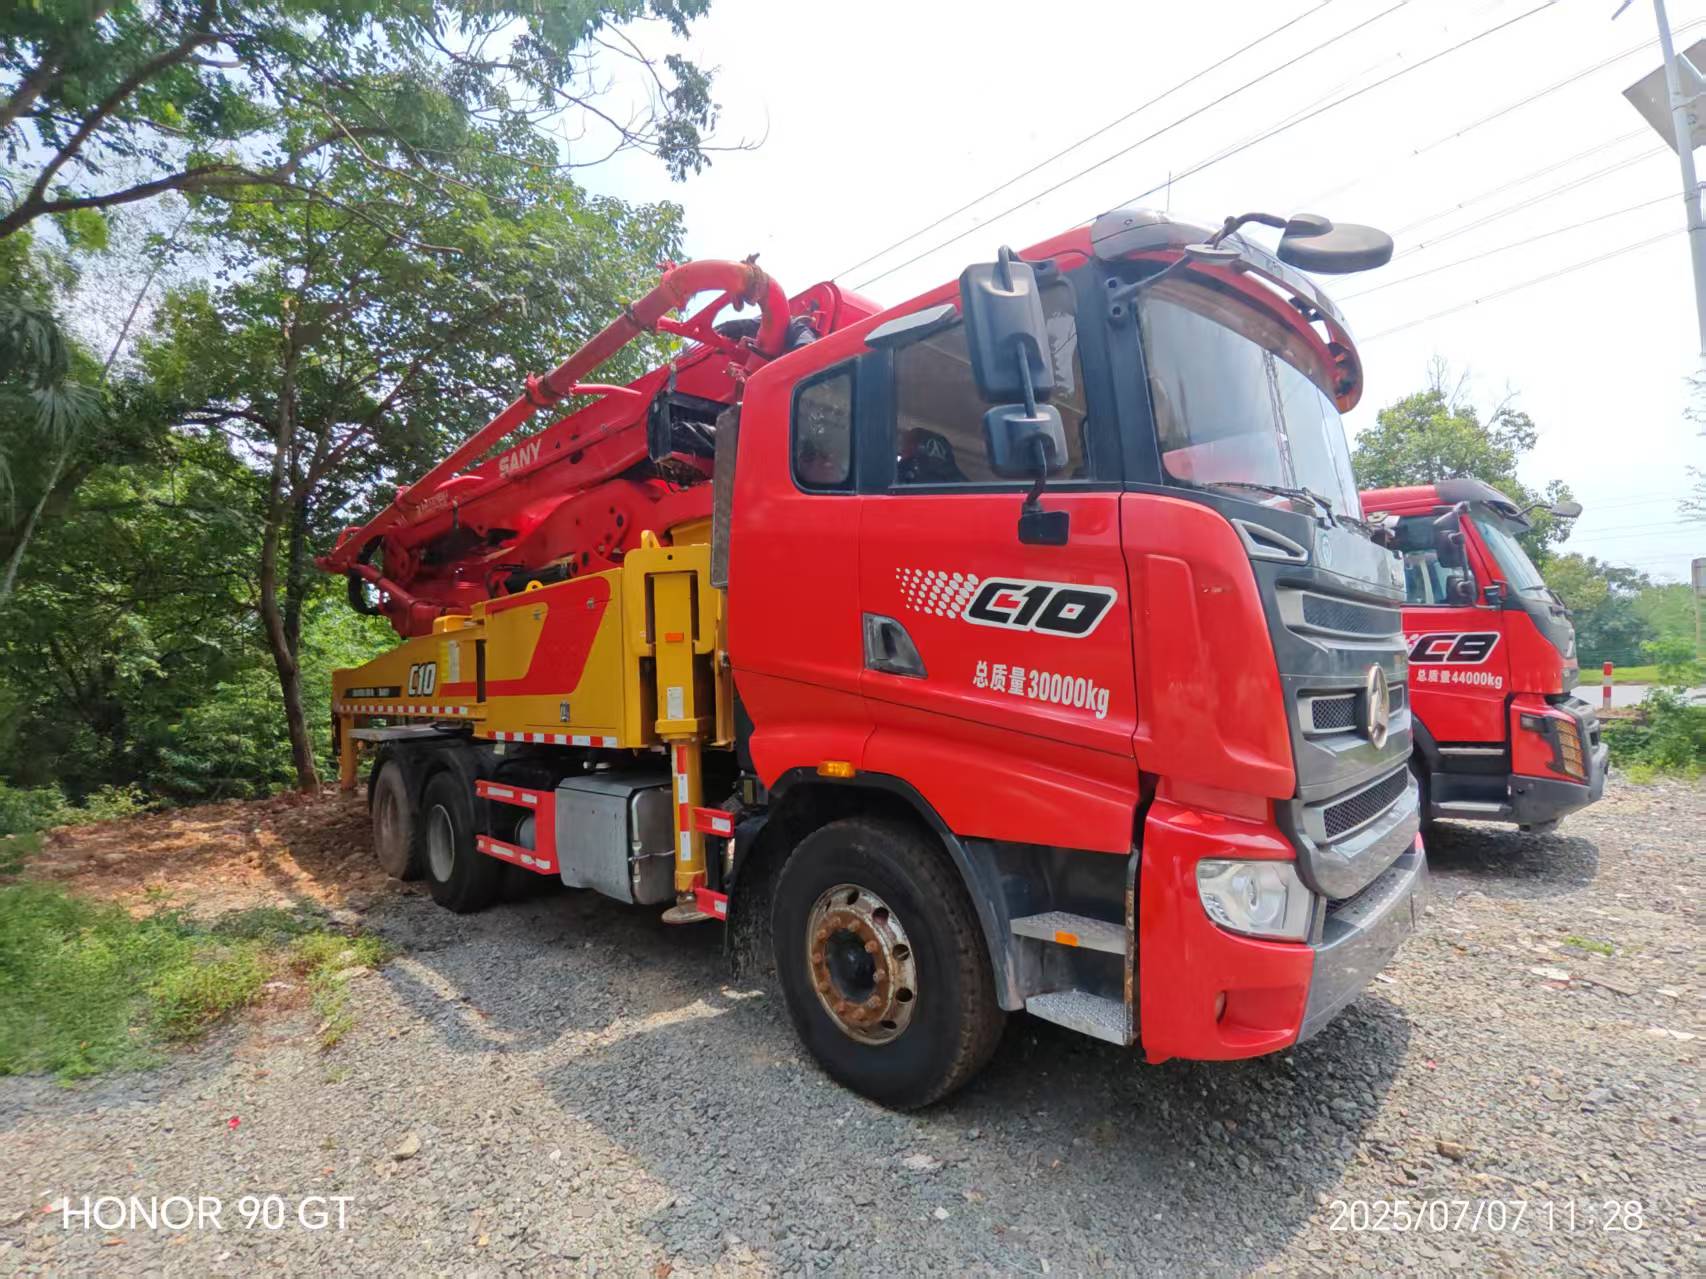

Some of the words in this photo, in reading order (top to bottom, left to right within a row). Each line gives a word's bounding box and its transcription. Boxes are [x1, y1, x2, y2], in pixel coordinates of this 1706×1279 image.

[499, 438, 542, 479] SANY
[964, 578, 1116, 637] C10
[408, 661, 436, 697] C10
